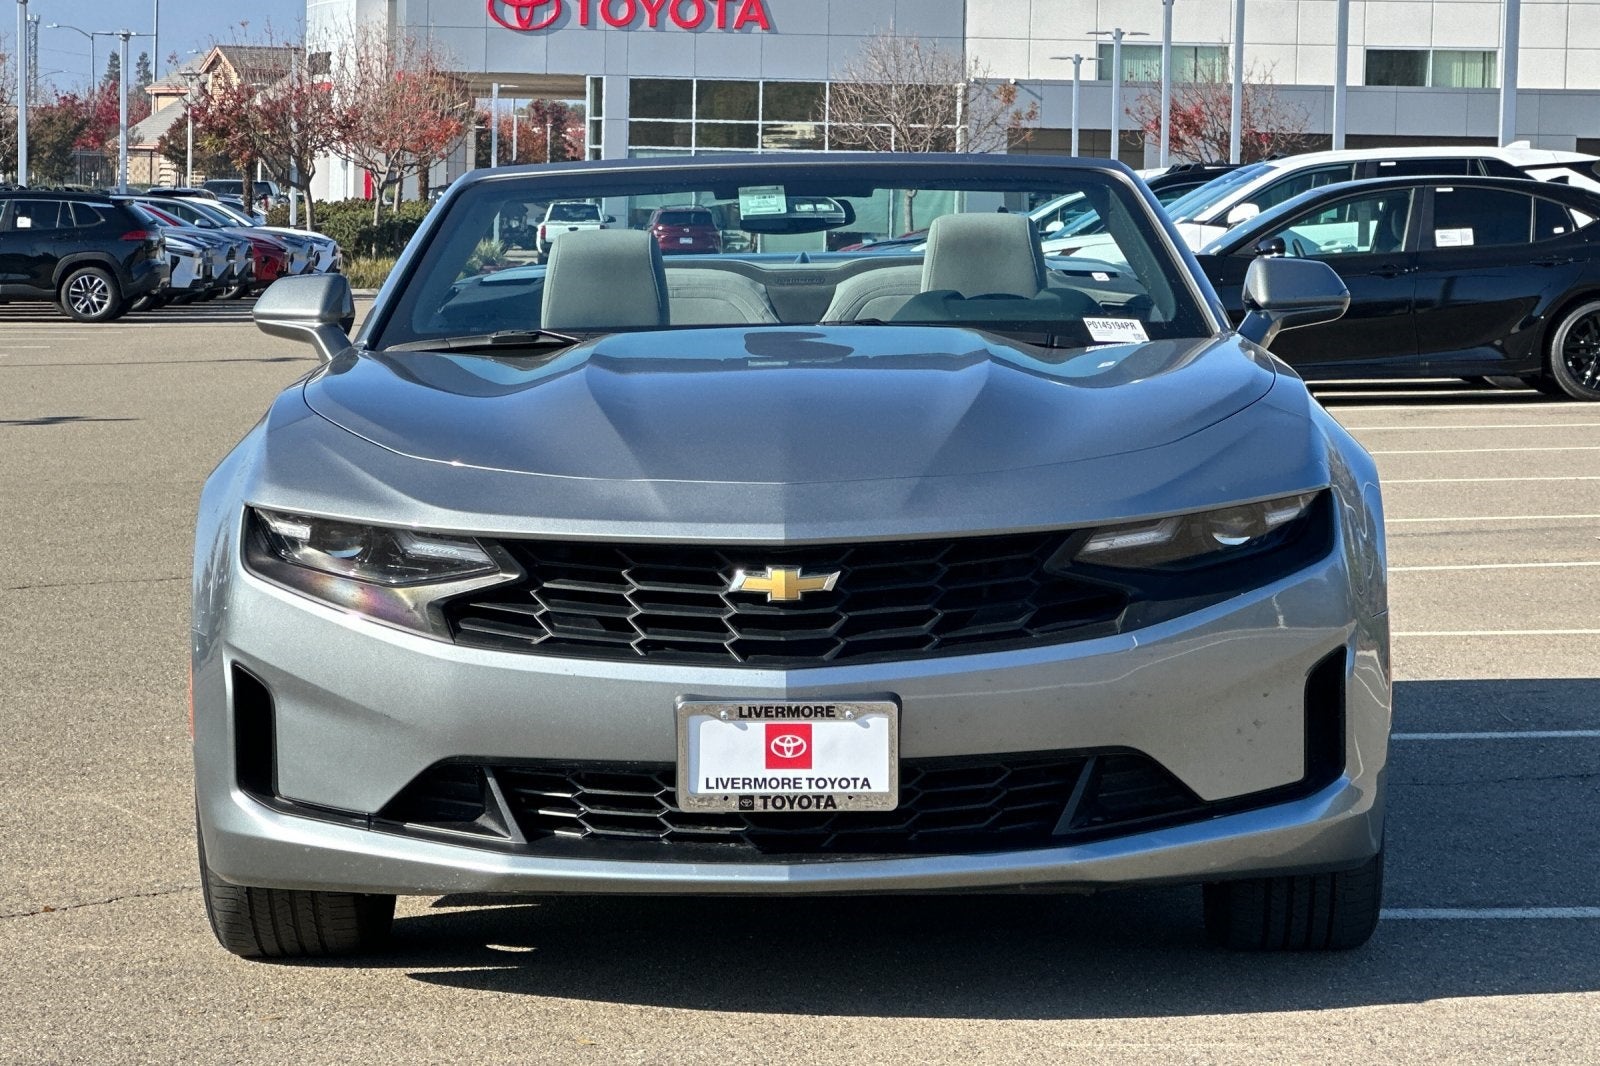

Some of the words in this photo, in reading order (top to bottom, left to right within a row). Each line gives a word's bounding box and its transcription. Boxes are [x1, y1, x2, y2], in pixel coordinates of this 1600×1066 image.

[738, 705, 836, 719] LIVERMORE
[705, 777, 803, 790] LIVERMORE
[806, 777, 872, 790] TOYOTA
[759, 795, 837, 810] TOYOTA
